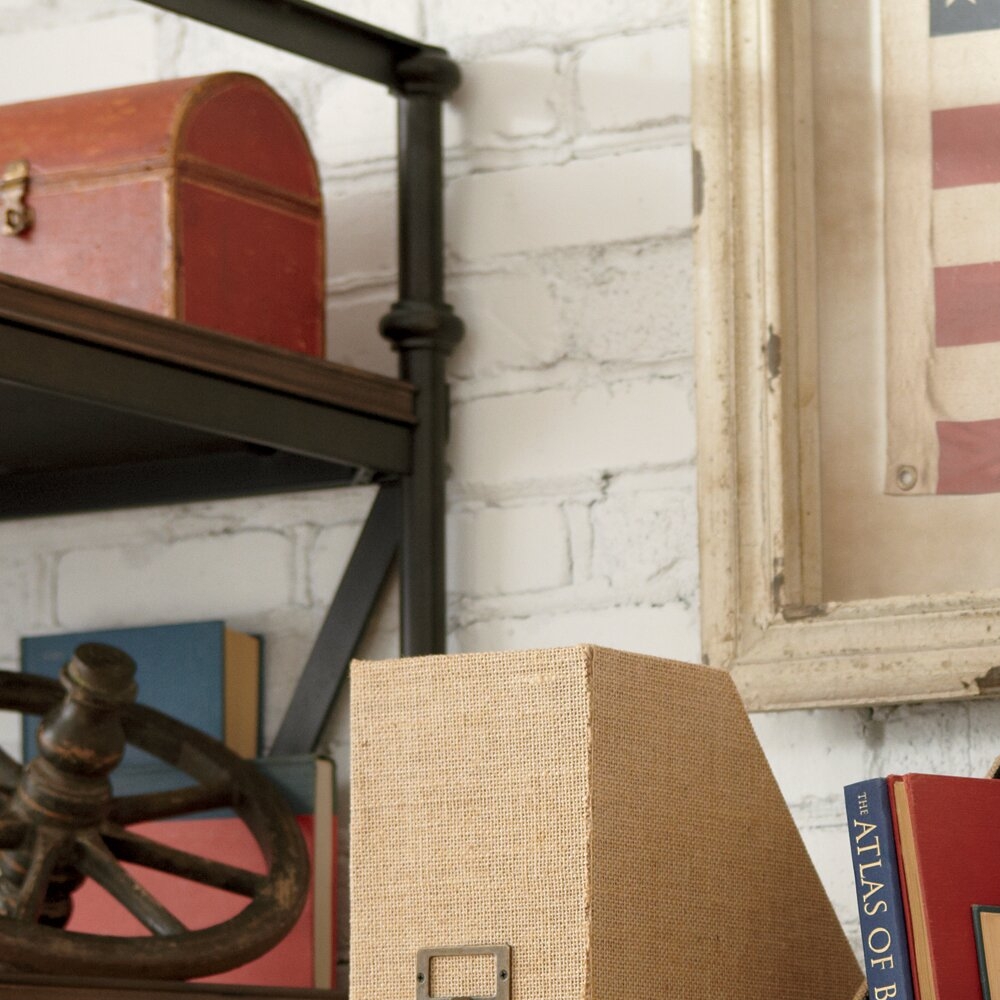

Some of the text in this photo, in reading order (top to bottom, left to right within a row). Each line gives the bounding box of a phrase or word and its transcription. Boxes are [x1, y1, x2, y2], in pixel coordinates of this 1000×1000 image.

[857, 791, 869, 816] THE
[853, 819, 888, 916] ATLAS
[868, 927, 894, 970] OF
